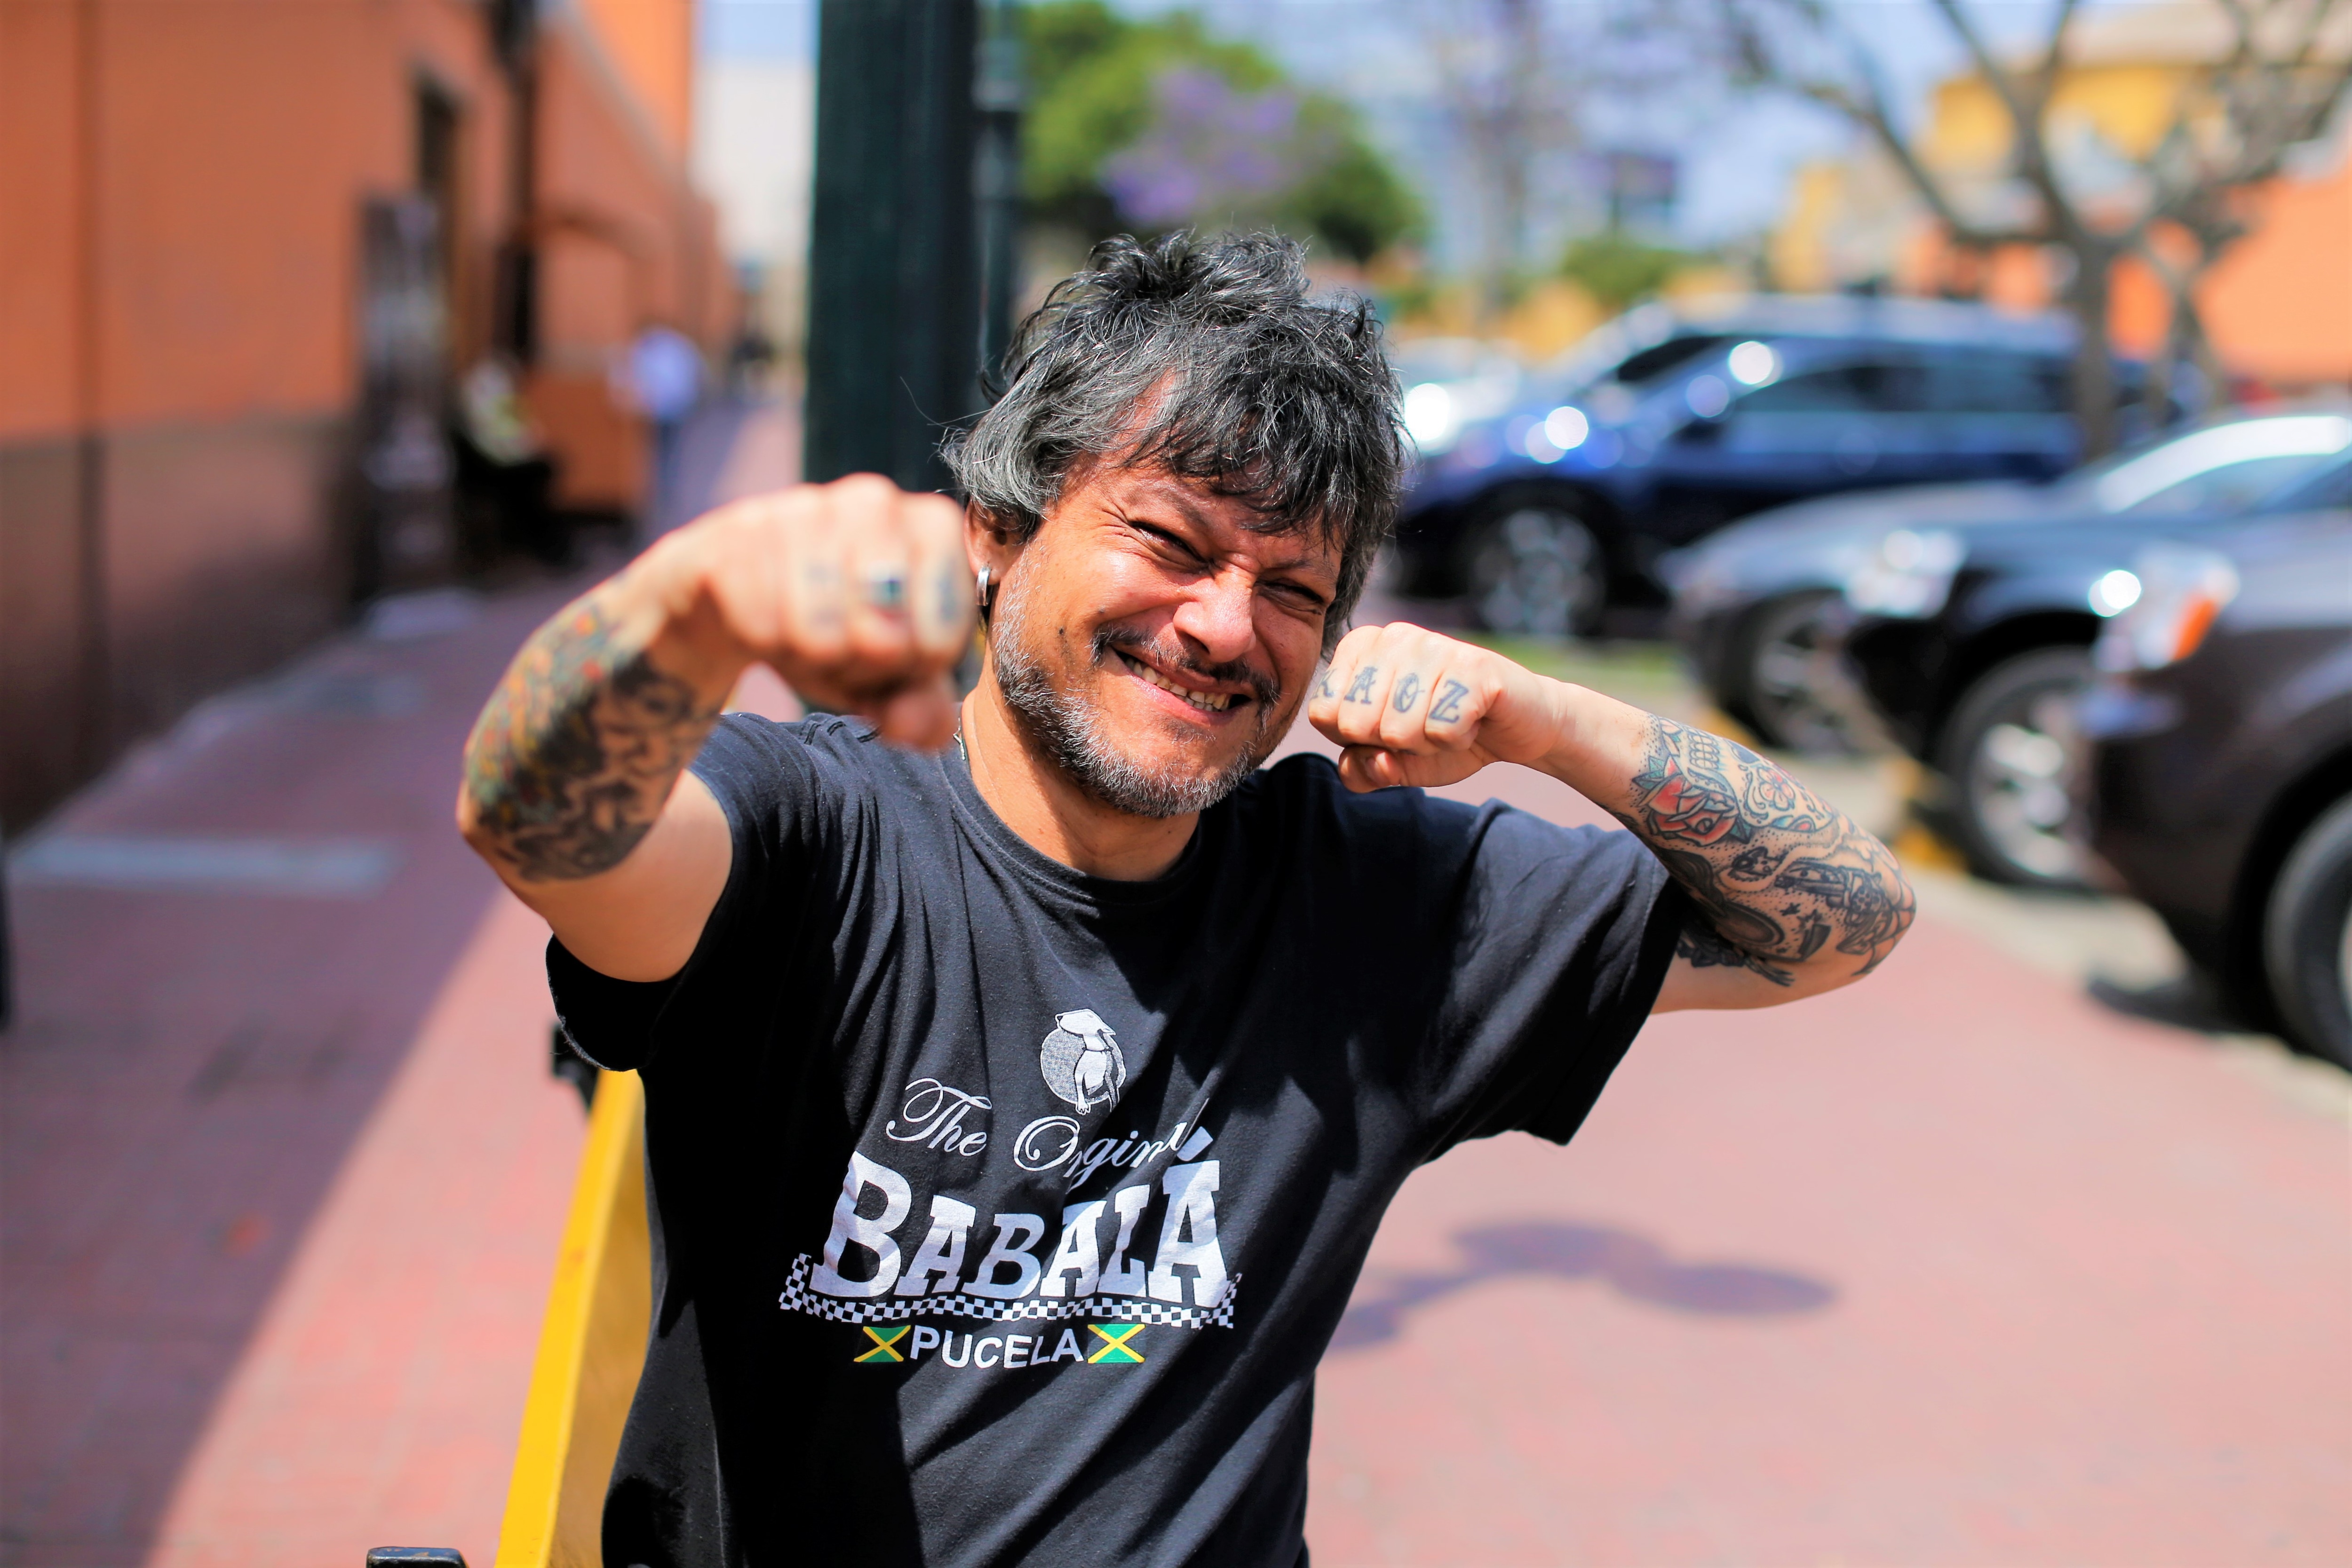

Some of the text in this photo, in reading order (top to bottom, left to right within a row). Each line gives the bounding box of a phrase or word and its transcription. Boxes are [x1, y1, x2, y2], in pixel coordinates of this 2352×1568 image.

[885, 1077, 992, 1156] The
[809, 1126, 1228, 1308] BABALÁ
[910, 1325, 1084, 1369] PUCELA
